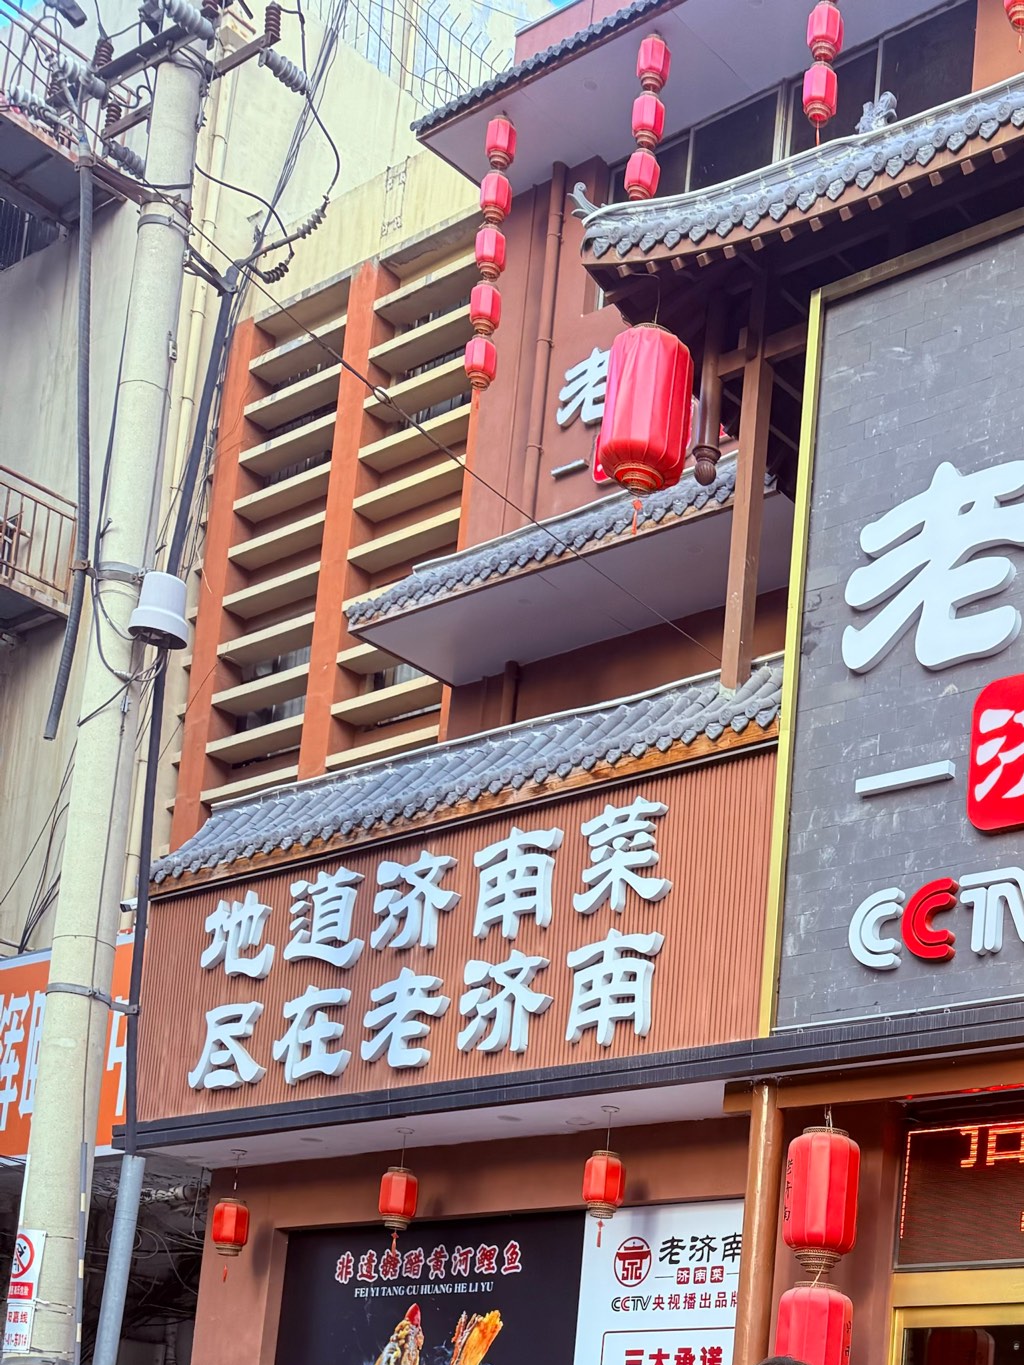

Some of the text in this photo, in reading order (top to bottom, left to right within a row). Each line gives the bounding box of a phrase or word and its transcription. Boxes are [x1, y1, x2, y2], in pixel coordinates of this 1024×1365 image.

[201, 795, 674, 980] 地道济南菜
[188, 928, 665, 1091] 尽在老济南
[354, 1281, 494, 1298] FEI YI TANG CU HUANG HE LI YU
